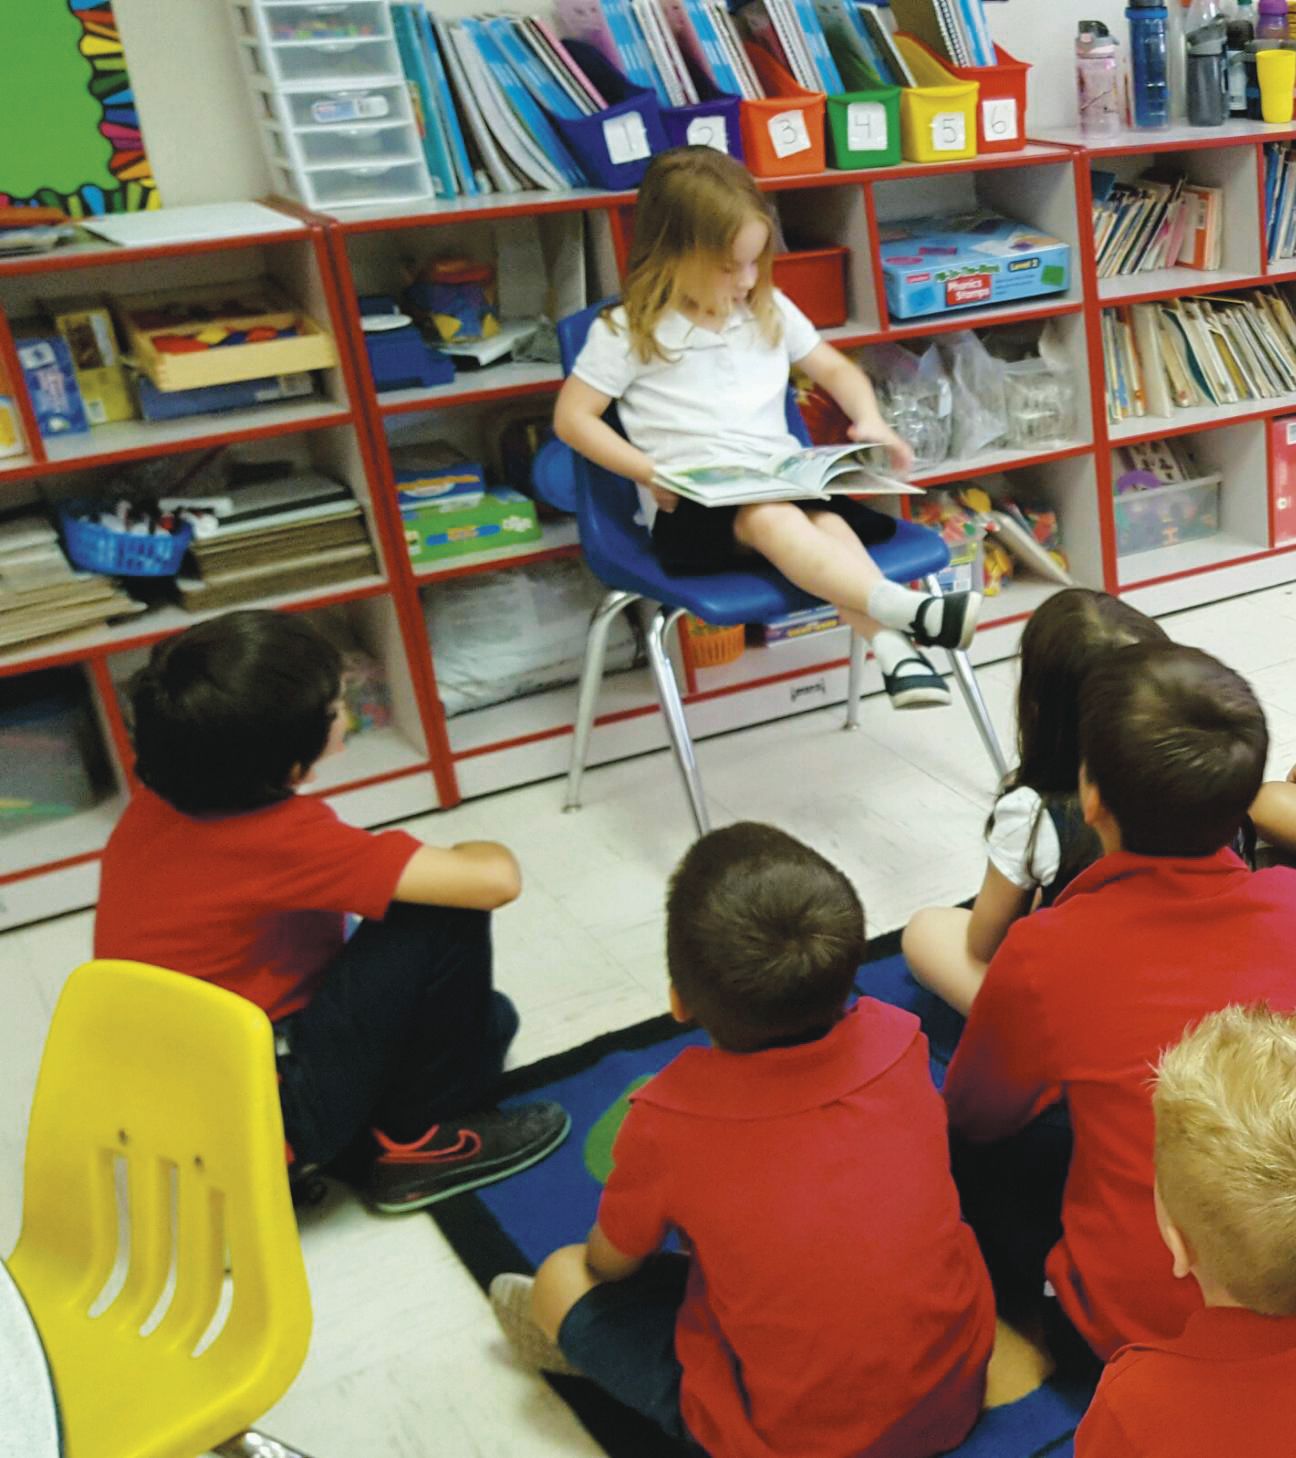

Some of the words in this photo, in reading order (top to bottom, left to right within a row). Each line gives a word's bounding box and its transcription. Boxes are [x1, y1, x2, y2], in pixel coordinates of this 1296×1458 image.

[778, 119, 798, 144] 3
[855, 114, 871, 139] 4
[942, 118, 958, 144] 5
[991, 105, 1006, 134] 6
[622, 121, 634, 152] 1
